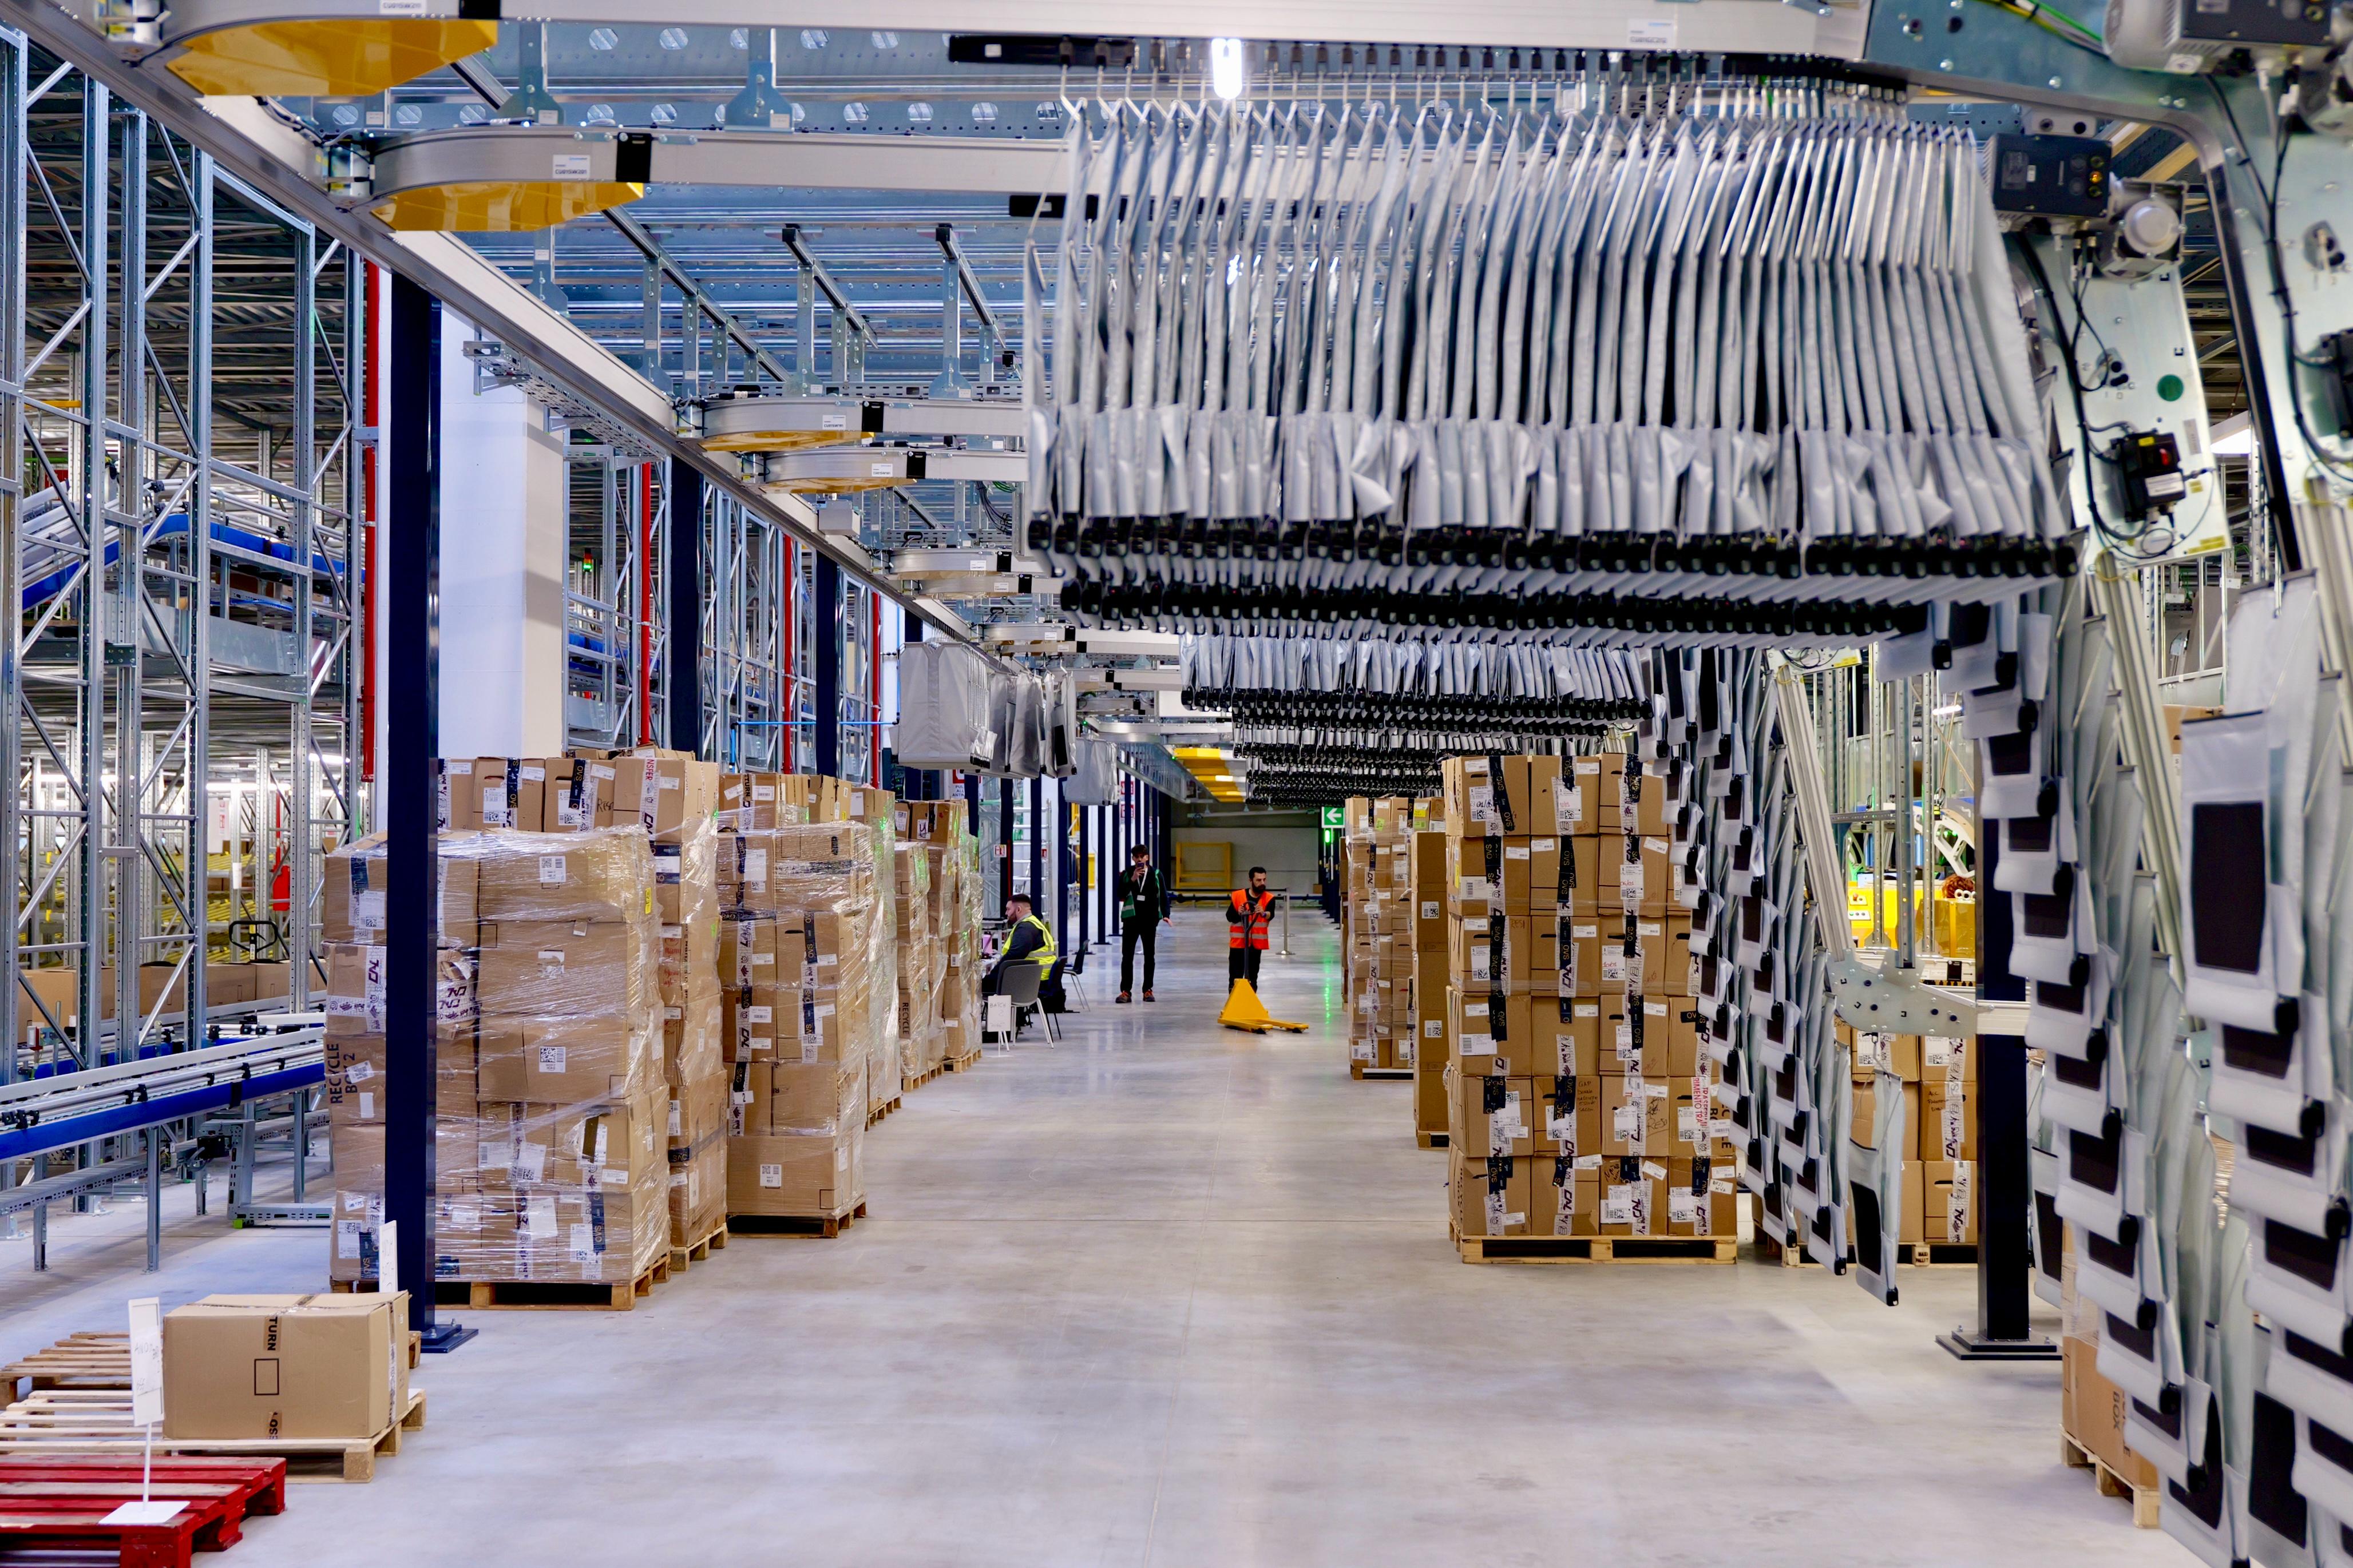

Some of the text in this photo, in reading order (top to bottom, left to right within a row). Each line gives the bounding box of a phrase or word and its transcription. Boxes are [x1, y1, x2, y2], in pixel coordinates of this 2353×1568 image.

[1496, 776, 1504, 791] OVS
[1504, 812, 1512, 827] OVS
[1686, 1011, 1697, 1019] OV
[327, 1043, 343, 1103] RECYCLE
[267, 1317, 278, 1351] TURN
